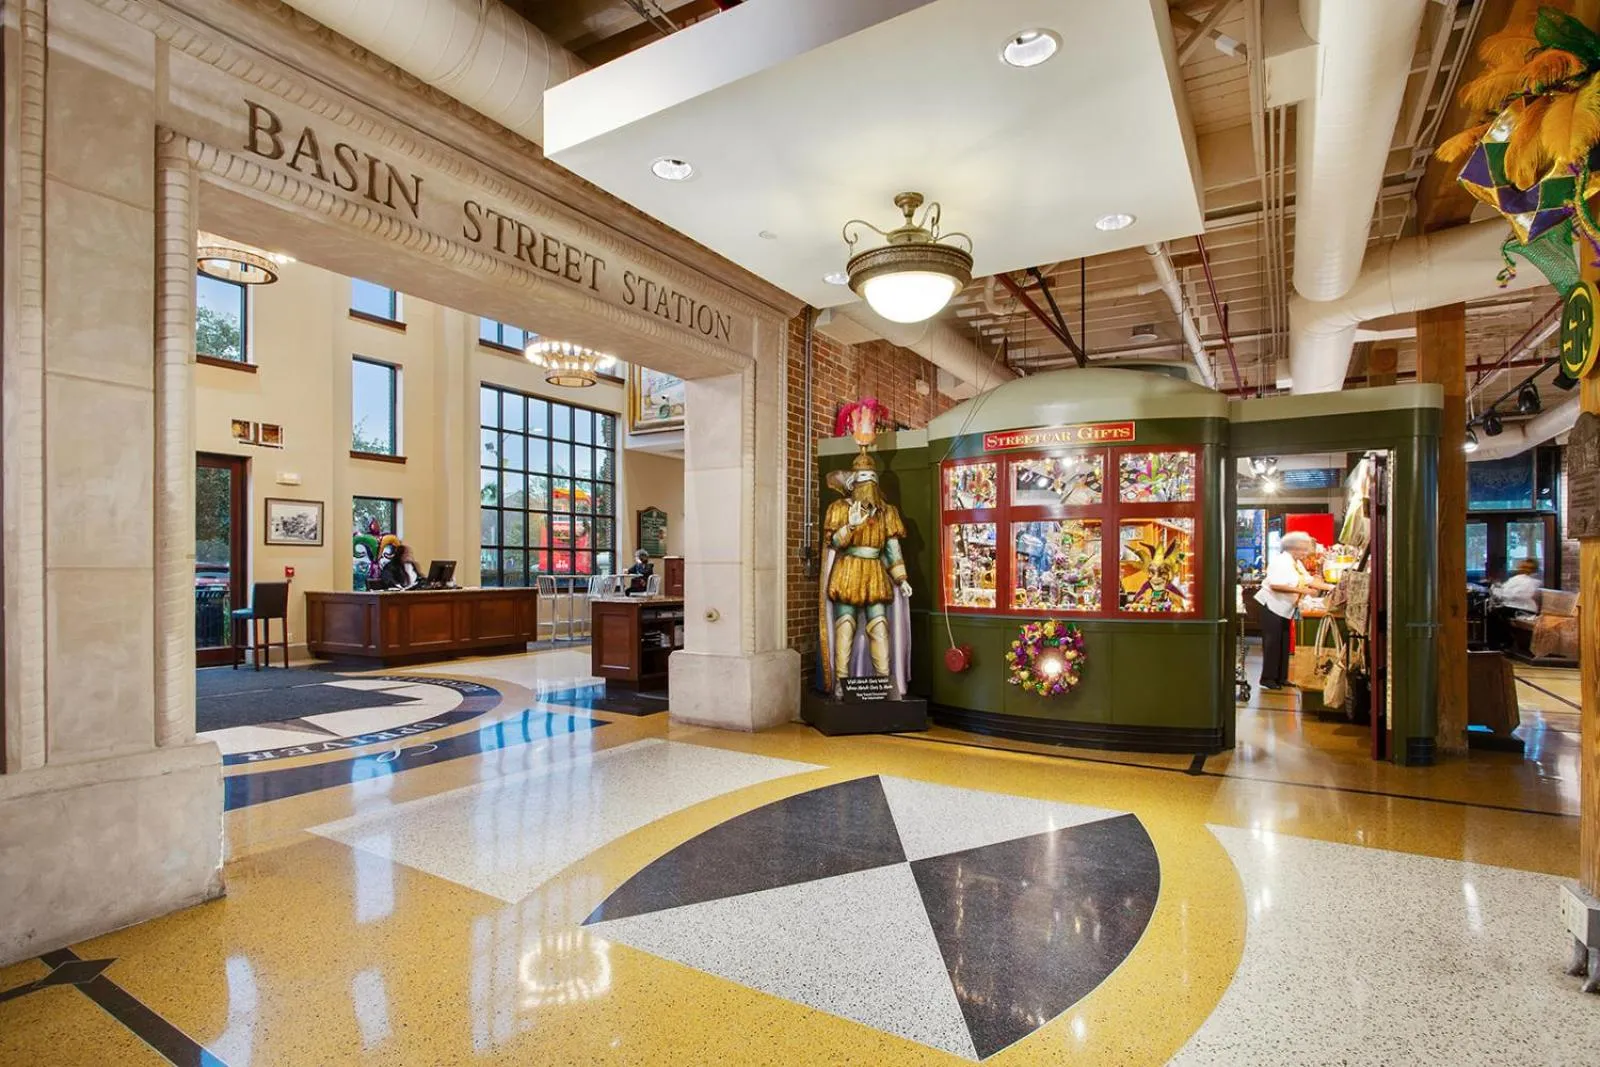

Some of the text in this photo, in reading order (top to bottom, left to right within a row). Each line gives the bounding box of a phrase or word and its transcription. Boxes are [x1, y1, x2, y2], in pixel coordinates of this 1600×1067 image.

[243, 98, 732, 342] BASIN STREET STATION
[986, 424, 1131, 449] STREETCAR GIFTS
